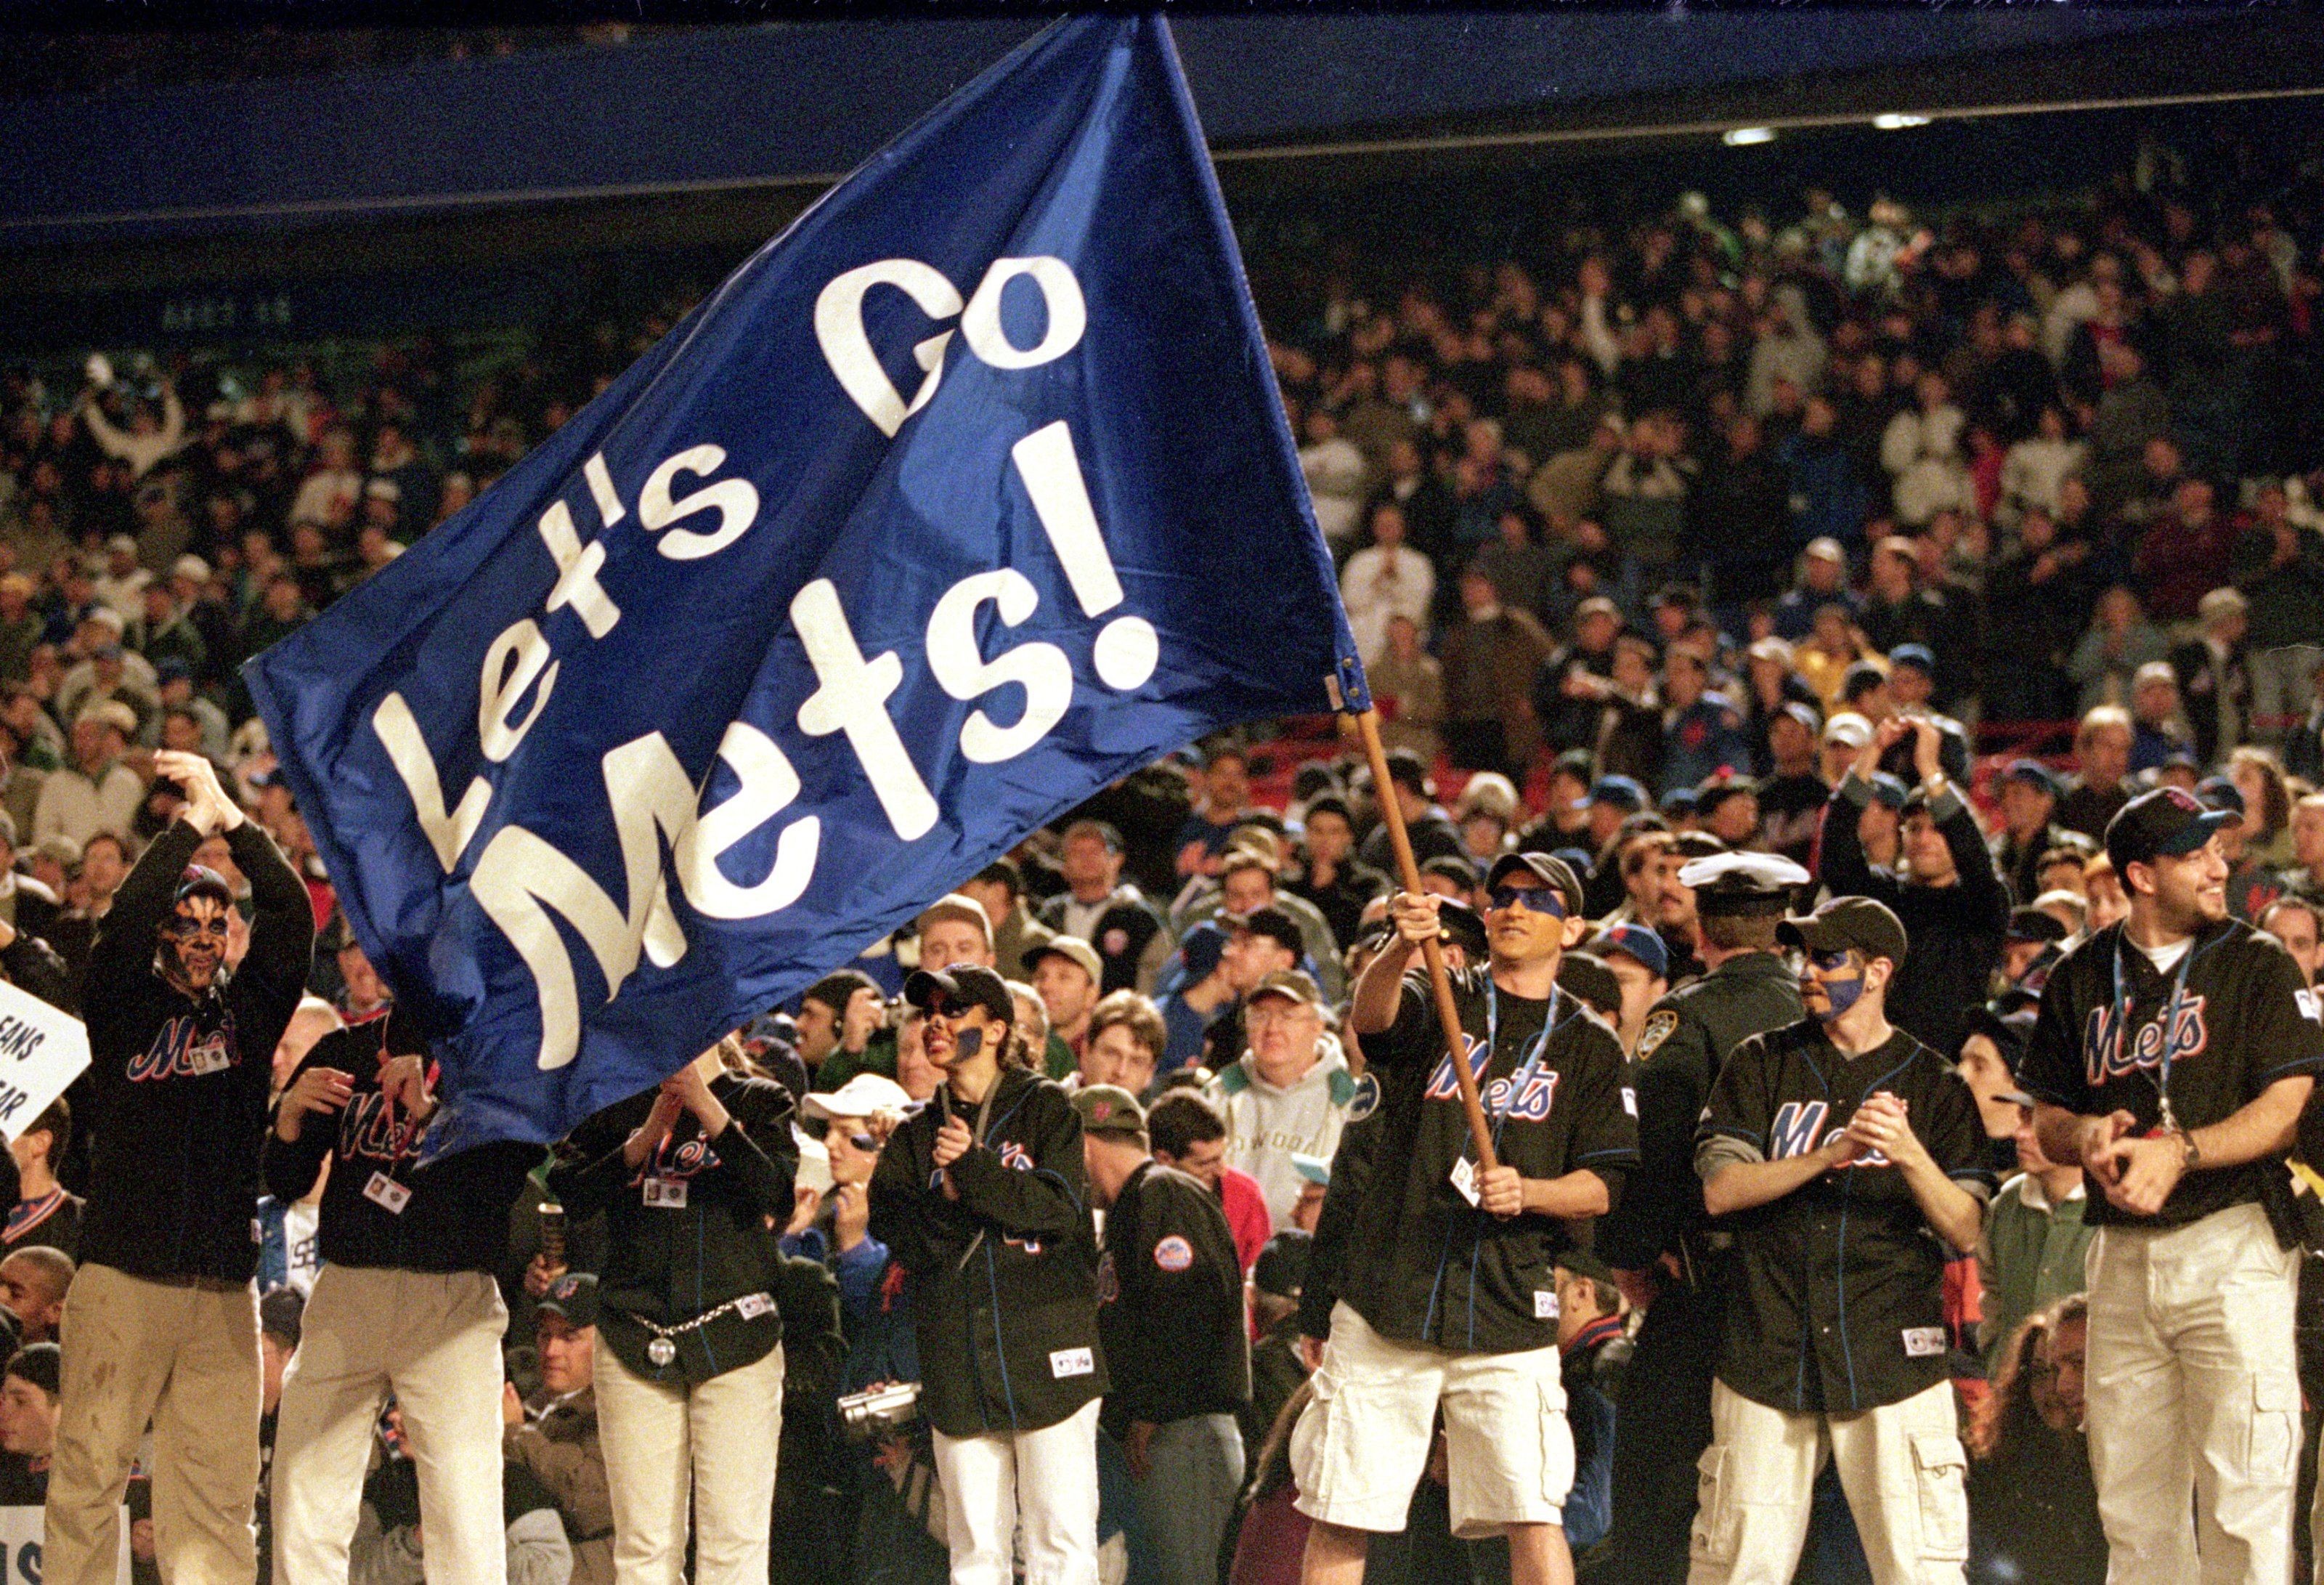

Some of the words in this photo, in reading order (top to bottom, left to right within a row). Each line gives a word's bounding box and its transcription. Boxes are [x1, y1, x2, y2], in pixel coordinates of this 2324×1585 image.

[372, 443, 760, 874] Let's
[814, 255, 1087, 438] Go
[469, 421, 1159, 1071] Mets!
[1424, 1032, 1560, 1122] Mets
[2084, 988, 2208, 1087] Mets
